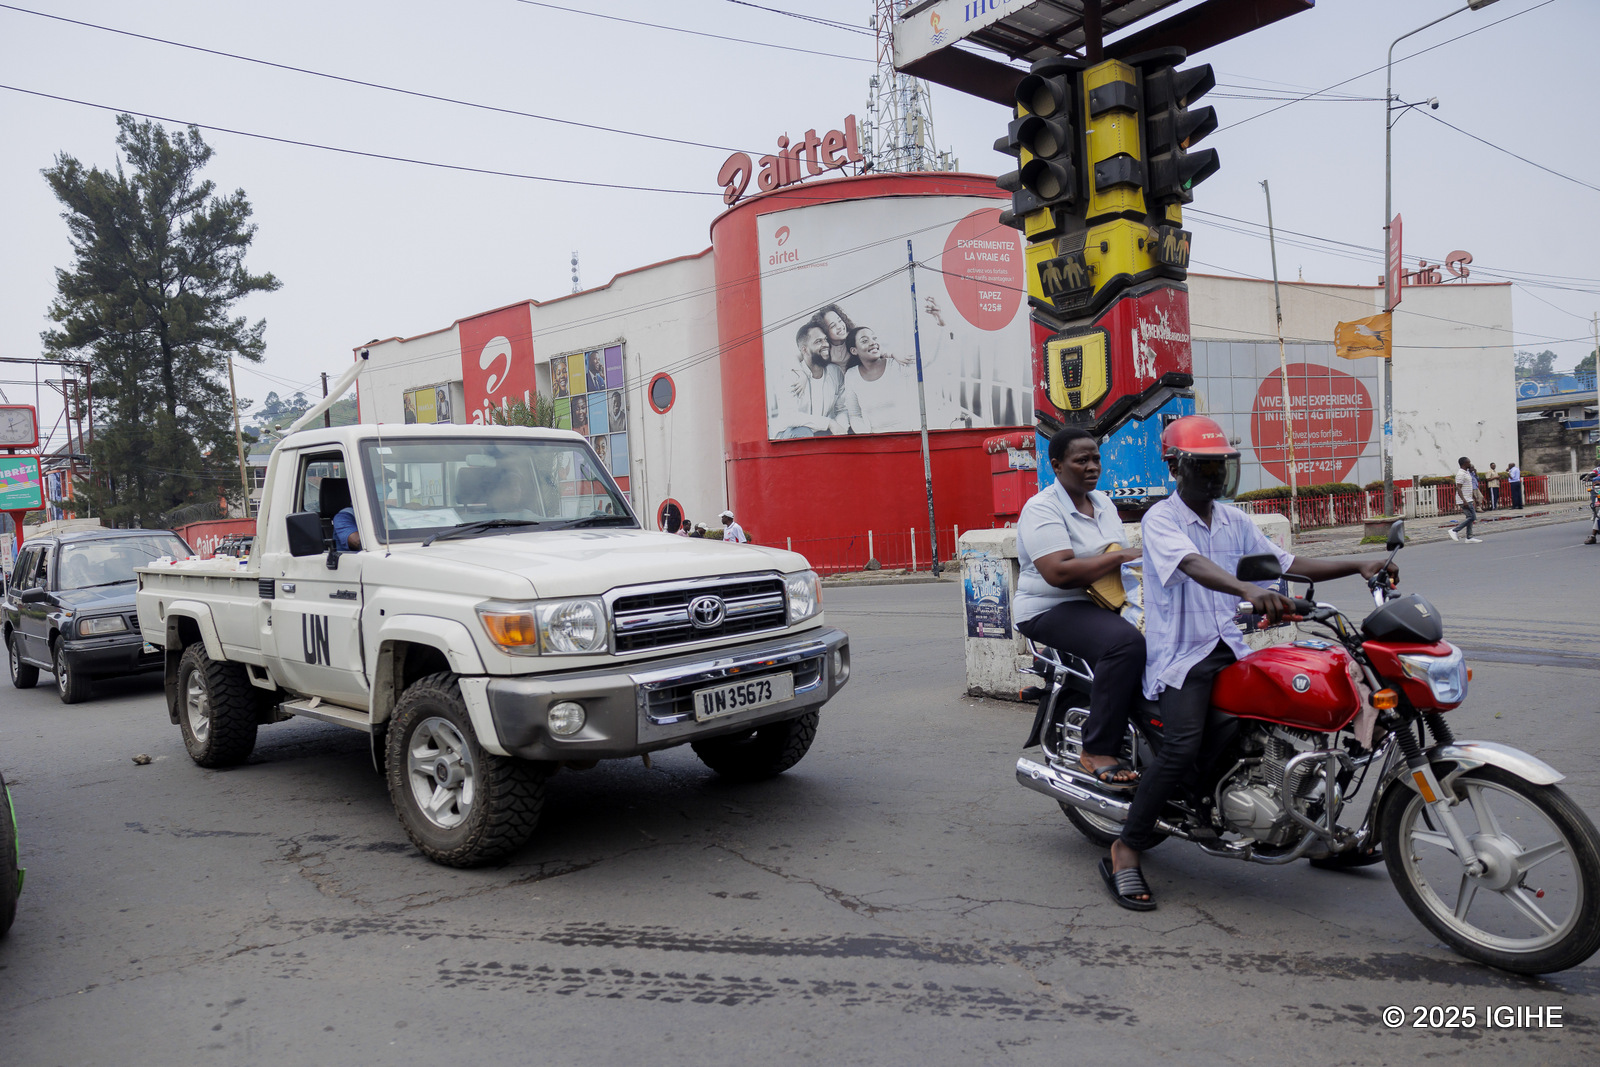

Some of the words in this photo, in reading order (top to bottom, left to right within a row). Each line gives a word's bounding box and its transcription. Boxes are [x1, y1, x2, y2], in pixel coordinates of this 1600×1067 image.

[964, 0, 1011, 22] IHU
[757, 113, 864, 193] airtel
[957, 240, 1015, 250] EXPERIMENTEZ
[769, 249, 799, 265] airtel
[964, 252, 975, 260] LA
[976, 252, 999, 261] VRAIE
[1000, 253, 1010, 262] 4G
[979, 291, 1002, 300] TAPEZ
[1309, 394, 1363, 406] EXPERIENCE
[1310, 409, 1324, 420] 4G
[1320, 429, 1343, 438] forfaits
[302, 613, 331, 667] UN
[702, 680, 773, 715] UN35673
